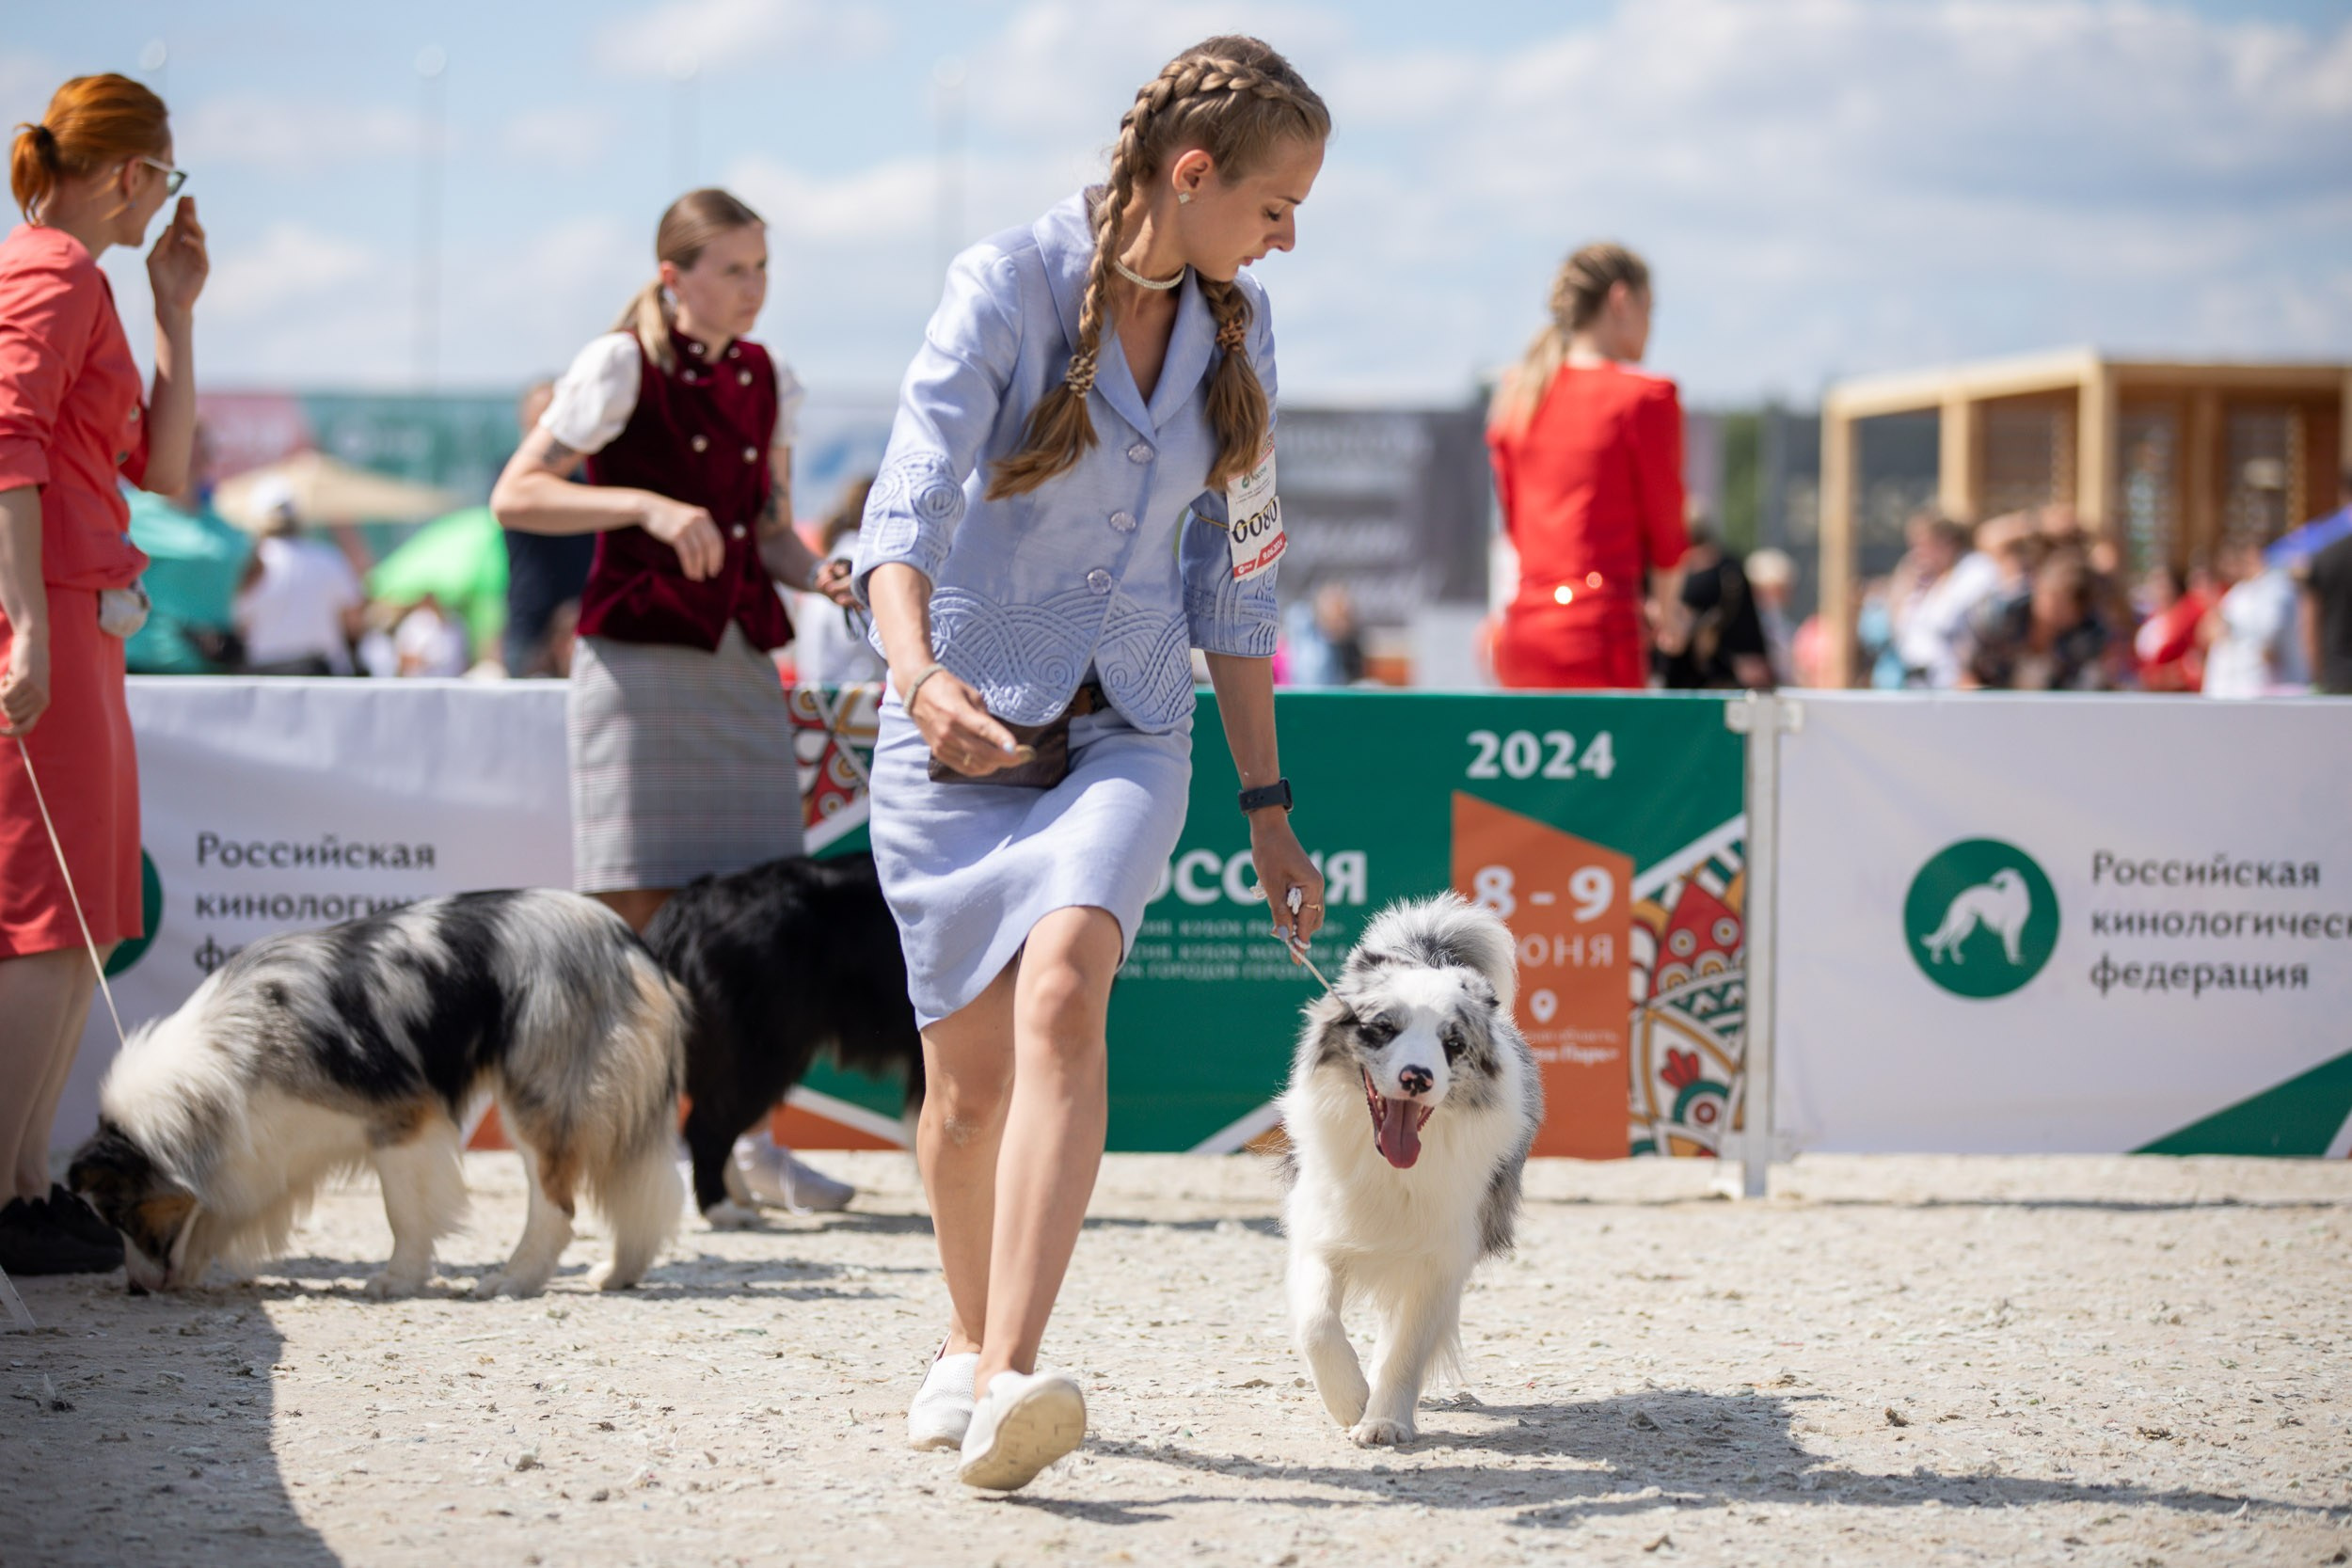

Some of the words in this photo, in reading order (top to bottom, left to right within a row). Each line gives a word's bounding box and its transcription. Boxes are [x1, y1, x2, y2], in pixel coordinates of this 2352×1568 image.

[1232, 497, 1278, 544] 0080
[1466, 729, 1616, 780] 2024
[197, 832, 436, 869] Российская
[2092, 849, 2320, 888] Российская
[1472, 865, 1517, 920] 8
[1568, 865, 1615, 924] 9
[1513, 933, 1613, 968] ЮНЯ
[2090, 951, 2308, 998] федерация
